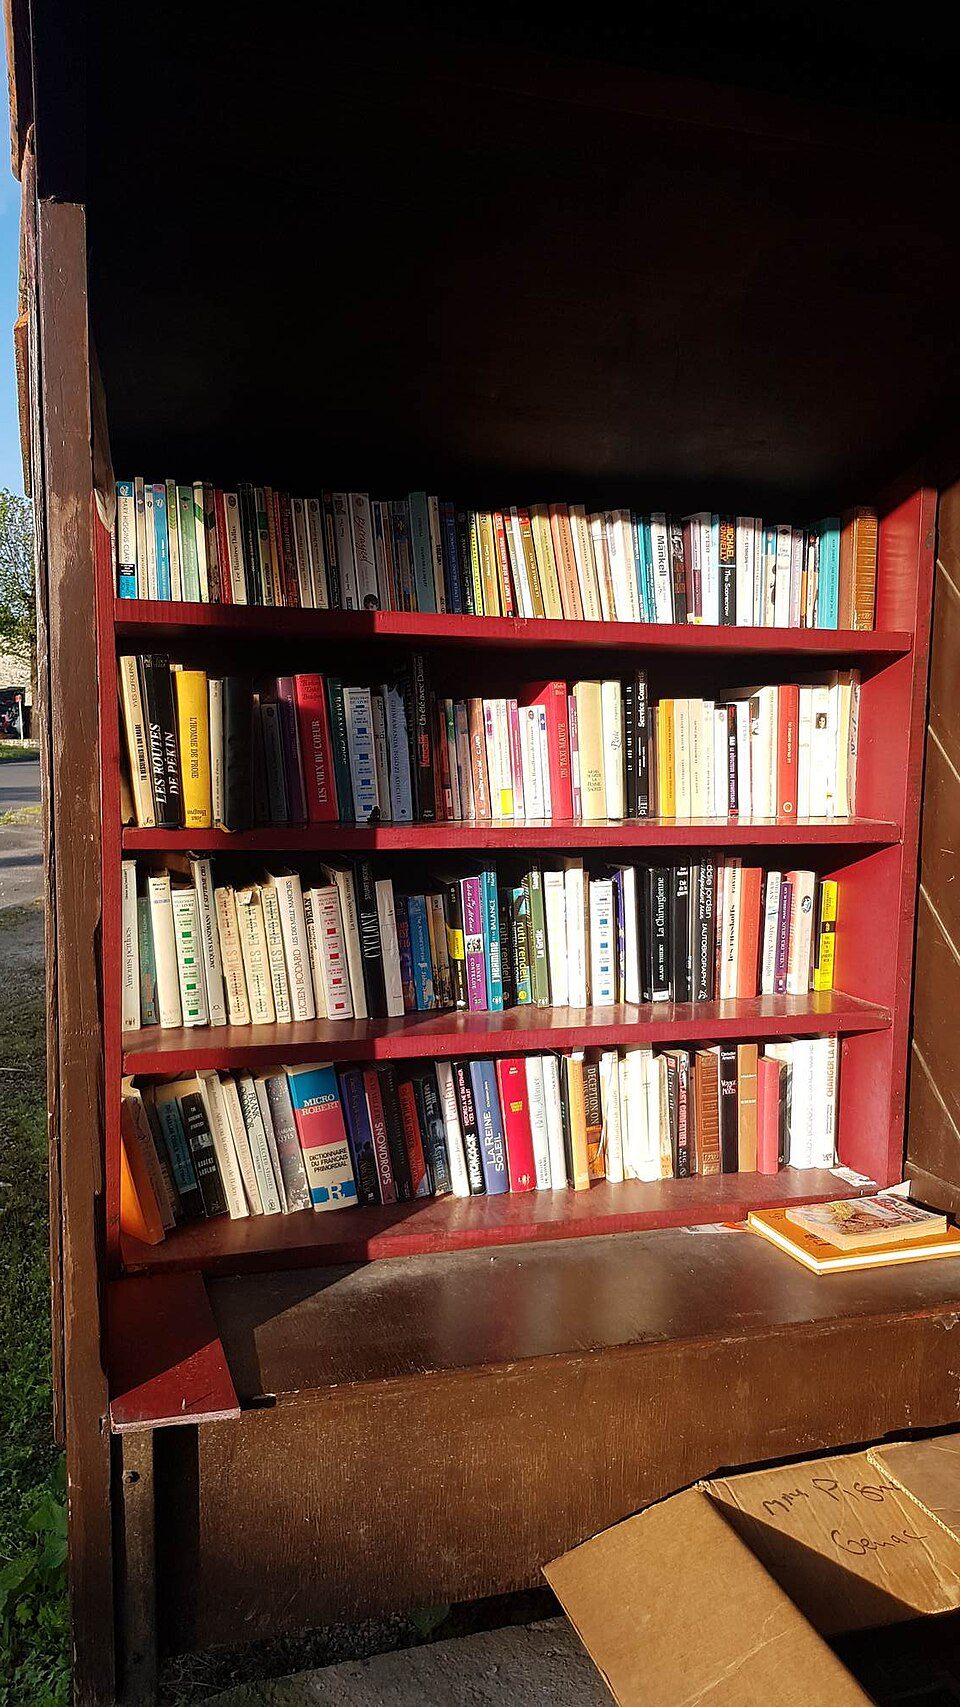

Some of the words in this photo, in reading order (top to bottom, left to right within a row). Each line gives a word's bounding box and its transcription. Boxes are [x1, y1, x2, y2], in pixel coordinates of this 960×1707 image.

[123, 516, 131, 542] HIGGINS
[657, 535, 667, 576] Mankell
[417, 684, 425, 700] avec
[189, 717, 199, 747] L'HOMME
[311, 720, 321, 749] COEUR
[558, 723, 566, 748] MAUVE
[149, 723, 164, 775] ROUTES
[164, 731, 178, 773] PÉKIN
[190, 749, 198, 758] DE
[315, 751, 323, 763] DU
[559, 750, 567, 766] TAXI
[190, 759, 199, 779] PROIE
[316, 764, 325, 785] VOIX
[154, 777, 167, 803] LES
[168, 777, 179, 795] DE
[319, 788, 328, 803] LES
[286, 880, 294, 908] MARCHES
[655, 877, 666, 926] Chirurgienne
[304, 897, 314, 924] DELLY
[124, 927, 133, 957] perdues
[205, 914, 214, 944] LANZMANN
[291, 936, 299, 946] LES
[360, 911, 381, 958] CYCLONE
[500, 923, 509, 944] ruth
[517, 922, 526, 944] ruth
[656, 927, 665, 937] La
[125, 958, 133, 989] Amours
[226, 950, 243, 996] HOMMES
[249, 950, 267, 996] HOMMES
[270, 950, 288, 996] HOMMES
[293, 949, 304, 984] BODARD
[501, 947, 511, 982] rendell
[518, 946, 528, 982] rendell
[766, 945, 774, 976] Midnight
[234, 1001, 246, 1019] LES
[256, 1001, 268, 1019] LES
[278, 1001, 289, 1018] LES
[297, 986, 307, 1017] LUCIEN
[827, 1049, 834, 1059] LA
[587, 1067, 598, 1110] DECEPTION
[826, 1060, 834, 1097] CHANGER
[248, 1092, 260, 1119] FRANK
[301, 1101, 339, 1116] ROBERT
[303, 1093, 335, 1108] MICRO
[424, 1084, 433, 1116] WHITE
[679, 1087, 687, 1104] LAST
[483, 1110, 494, 1145] REINE
[590, 1112, 600, 1125] ON
[678, 1105, 687, 1147] GODFATHER
[258, 1133, 268, 1166] COLLECTED
[309, 1147, 348, 1161] DICTIONNAIRE
[375, 1122, 392, 1185] SNOWDROPS
[434, 1142, 442, 1162] LAST
[465, 1133, 483, 1188] HITCHCOCK
[487, 1148, 496, 1164] LA
[494, 1132, 505, 1172] SOLEIL
[314, 1161, 347, 1173] PRIMORDIAL
[435, 1162, 445, 1179] RITES
